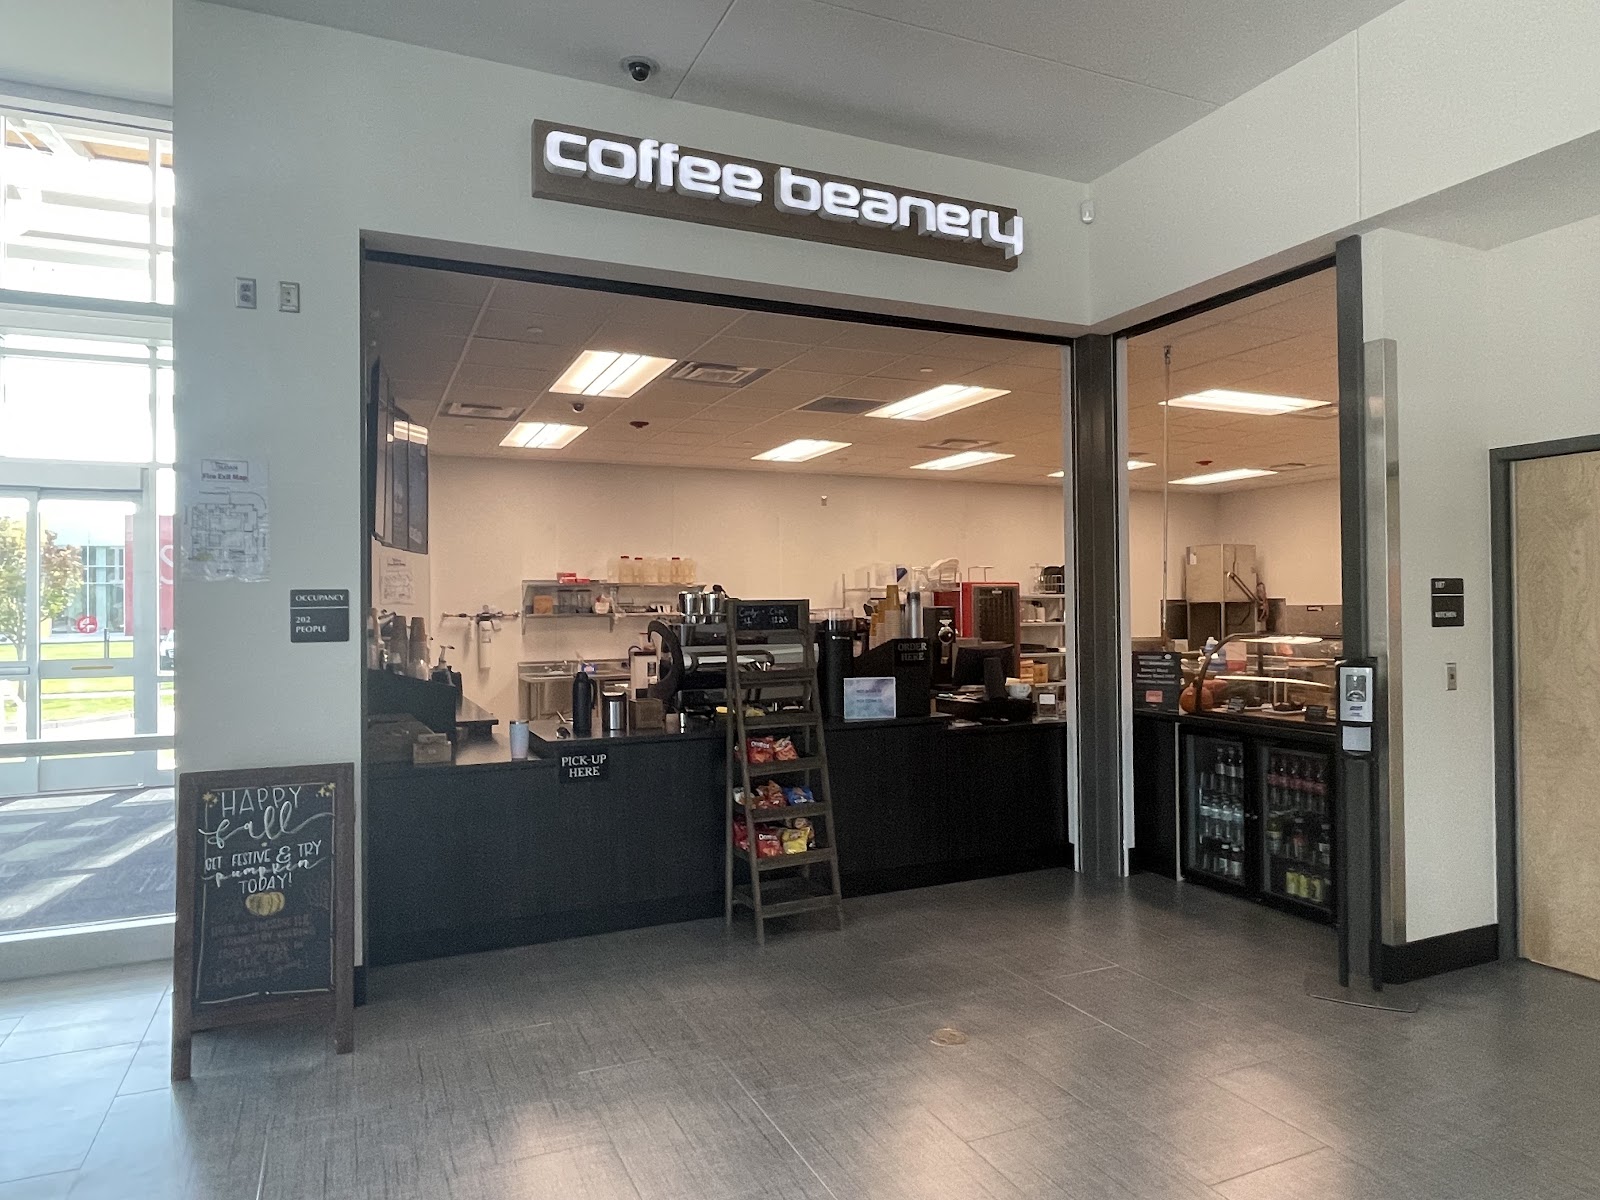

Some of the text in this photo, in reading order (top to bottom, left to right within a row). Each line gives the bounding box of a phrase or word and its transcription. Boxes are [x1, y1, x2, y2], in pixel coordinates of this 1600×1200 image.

[544, 130, 1024, 260] coffee beanery
[232, 474, 249, 482] Map
[295, 594, 345, 602] OCCUPANCY
[295, 616, 311, 624] 202
[295, 625, 327, 633] PEOPLE
[897, 641, 928, 652] ORDER
[900, 651, 925, 662] HERE
[561, 753, 607, 767] PICK-UP
[569, 766, 600, 778] HERE
[221, 786, 302, 817] HAPPY
[198, 801, 335, 849] fall
[205, 839, 322, 871] GET FESTIVE & TRY
[238, 871, 293, 894] TODAY!
